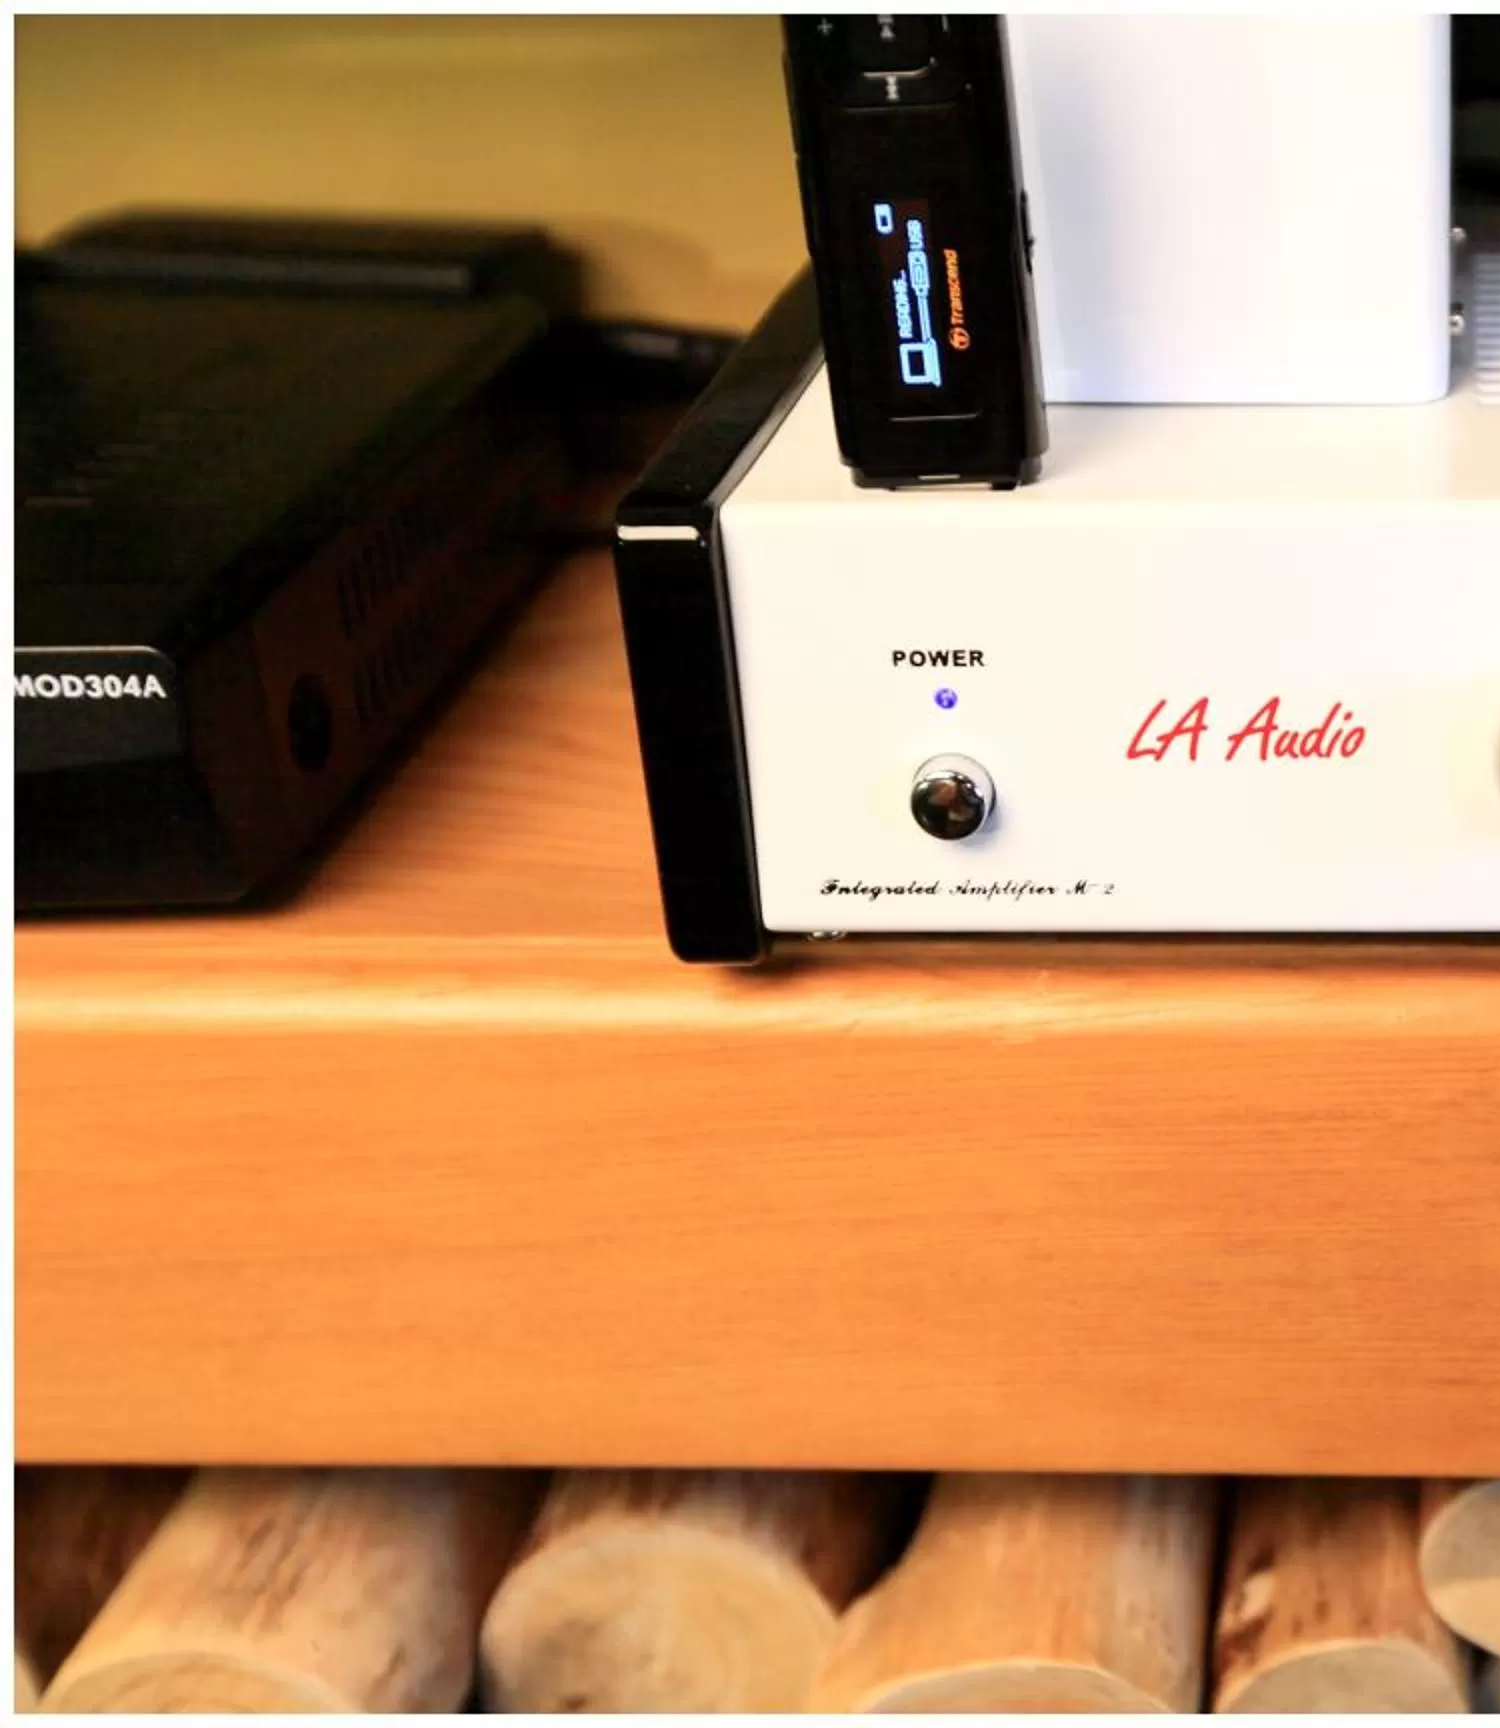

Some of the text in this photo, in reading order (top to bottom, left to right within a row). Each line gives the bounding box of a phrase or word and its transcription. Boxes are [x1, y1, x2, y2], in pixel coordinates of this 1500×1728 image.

[906, 219, 923, 249] USB
[943, 248, 965, 325] Transcend
[892, 649, 985, 668] POWER
[14, 673, 166, 698] MOD304A
[1126, 696, 1367, 762] LA Audio
[819, 878, 940, 902] Integrated
[948, 878, 1056, 901] Amplifier
